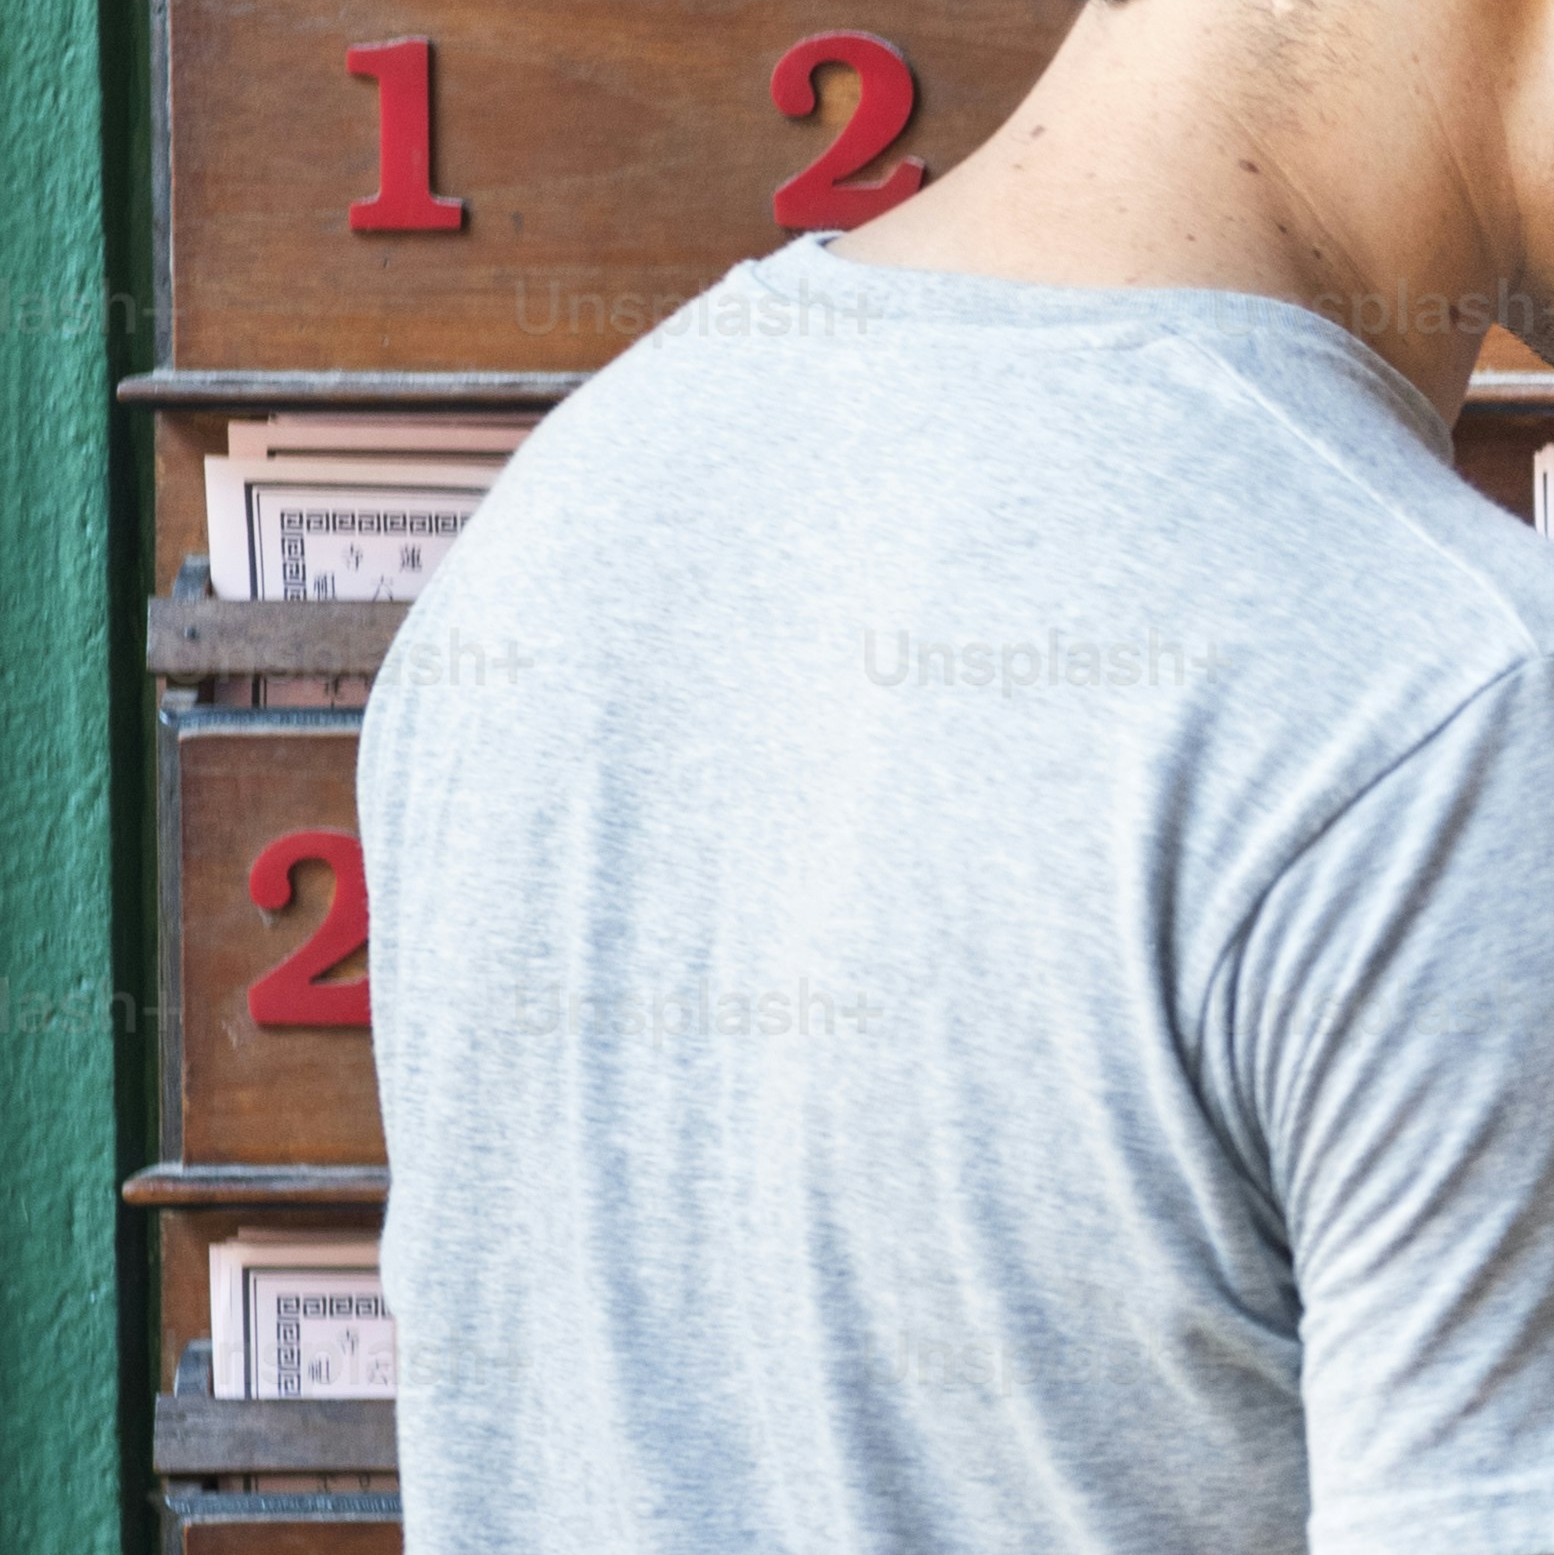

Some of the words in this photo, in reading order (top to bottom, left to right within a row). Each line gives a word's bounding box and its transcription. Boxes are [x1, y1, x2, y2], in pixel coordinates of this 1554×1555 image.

[346, 37, 462, 230] 1
[771, 30, 927, 230] 2
[248, 829, 371, 1025] 2
